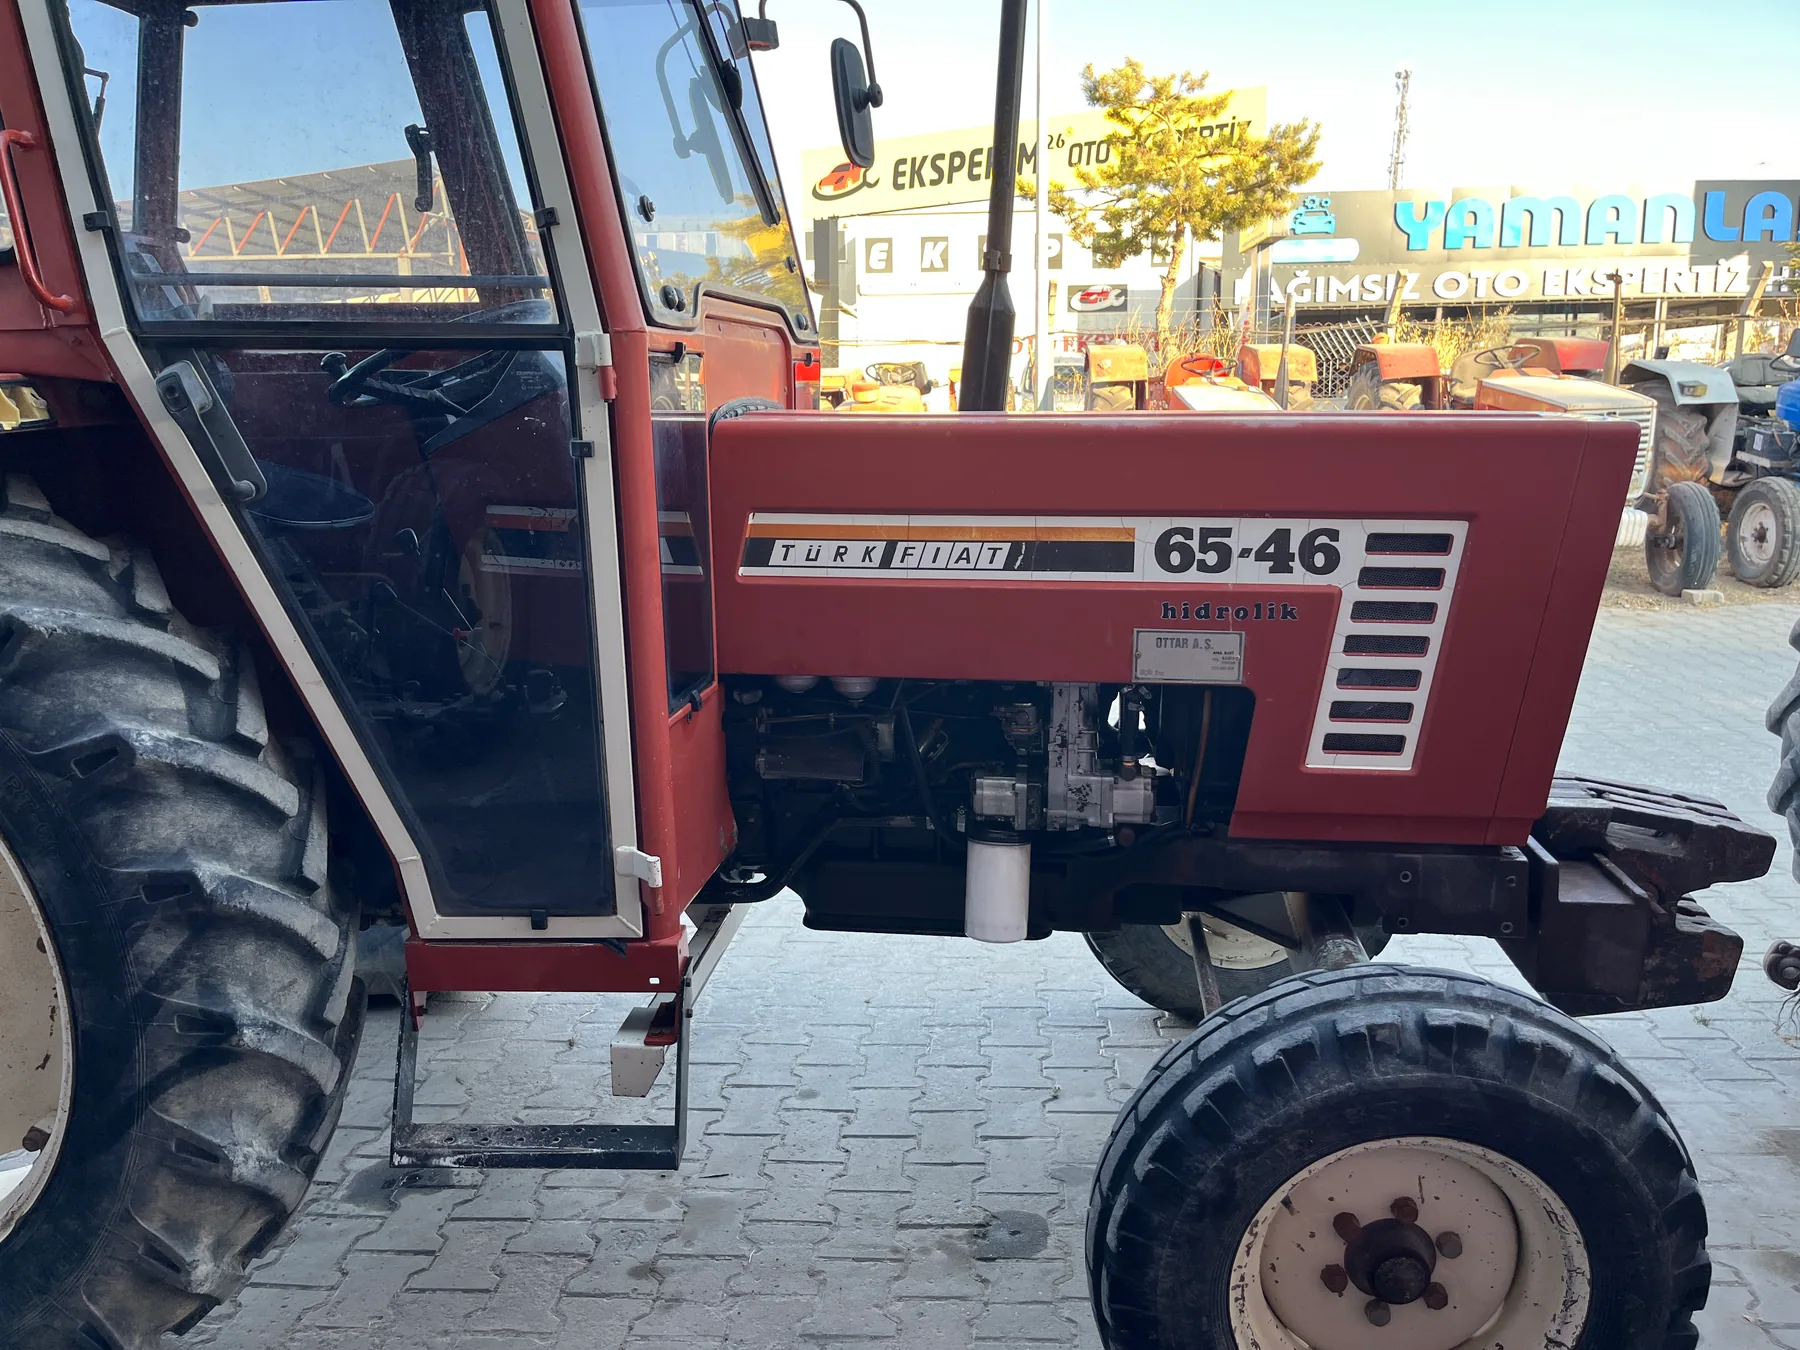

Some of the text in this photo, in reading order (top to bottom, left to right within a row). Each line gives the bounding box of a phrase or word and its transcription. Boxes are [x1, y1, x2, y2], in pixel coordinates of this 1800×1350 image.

[892, 141, 1037, 191] EKSPEM
[1067, 139, 1111, 168] OTO
[1393, 190, 1800, 252] YAMANLA
[1432, 268, 1530, 299] OTO
[1542, 257, 1751, 296] EKSPERTİZ
[781, 544, 1003, 565] TÜRK FIAT
[1154, 526, 1341, 576] 65-46
[1160, 601, 1299, 620] hidrolik
[1155, 637, 1189, 649] OTTAR
